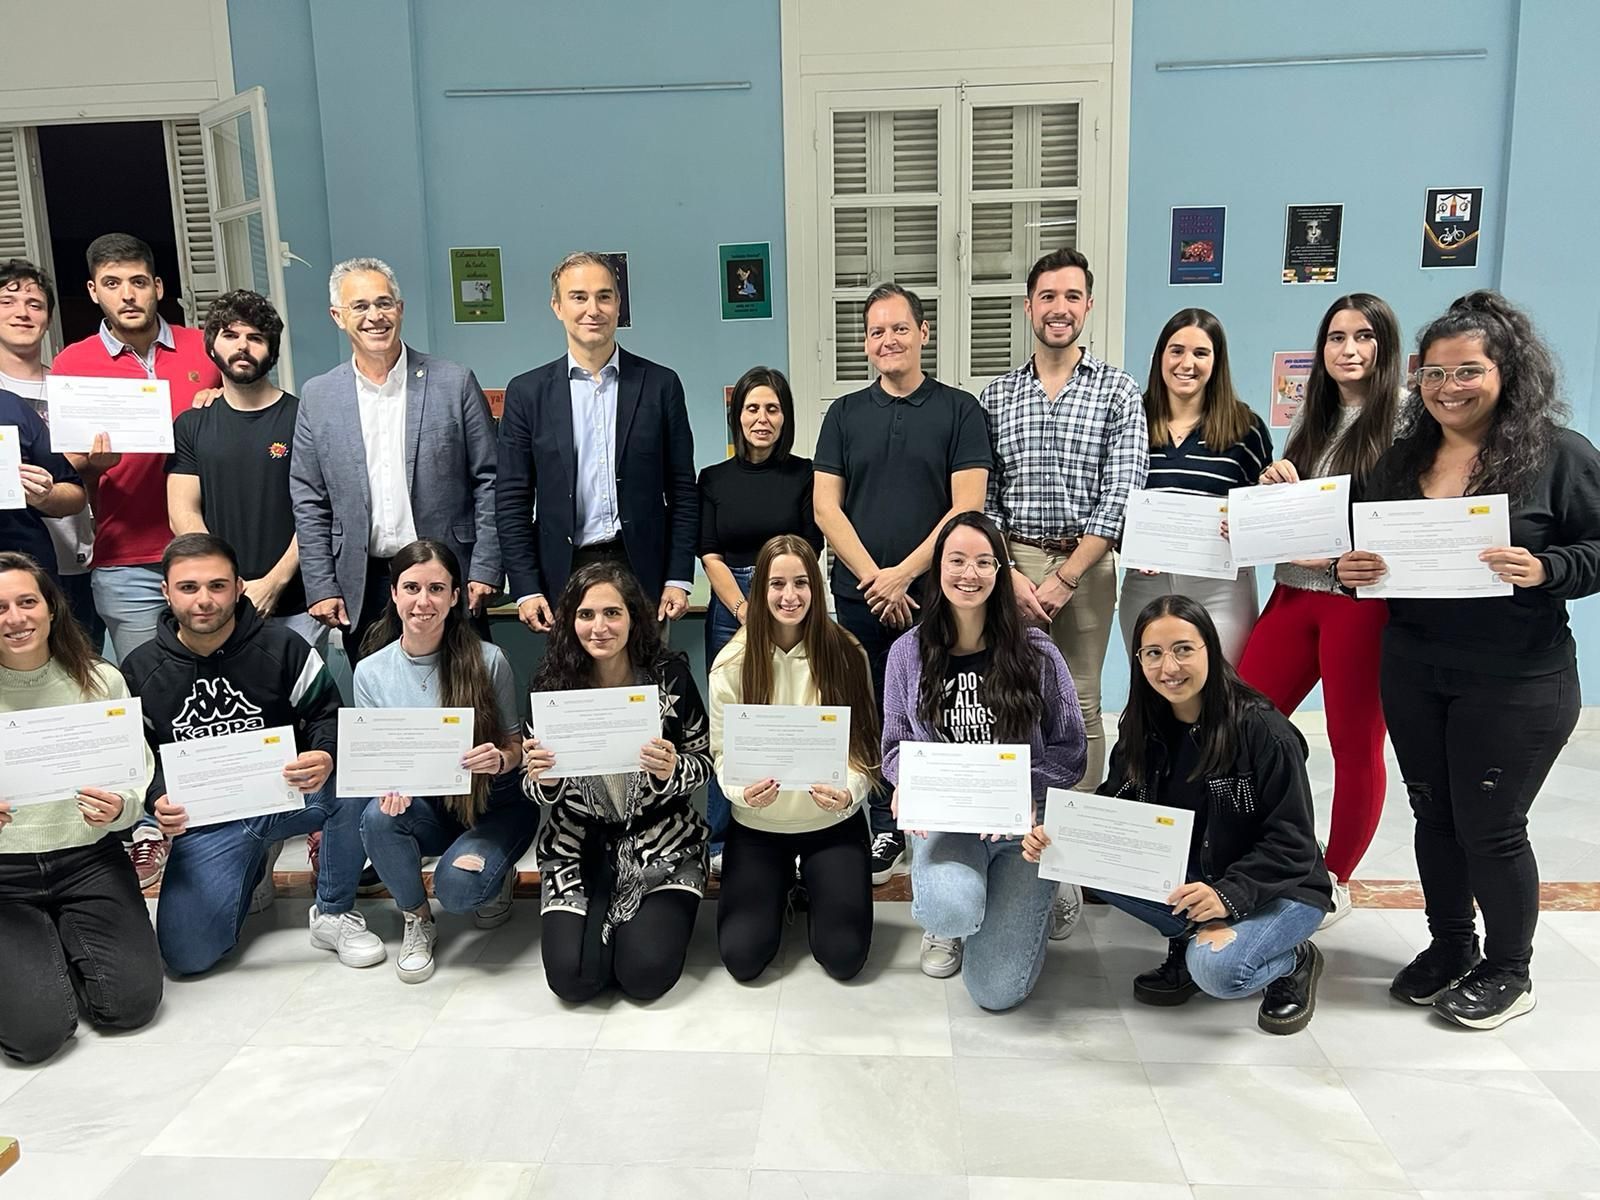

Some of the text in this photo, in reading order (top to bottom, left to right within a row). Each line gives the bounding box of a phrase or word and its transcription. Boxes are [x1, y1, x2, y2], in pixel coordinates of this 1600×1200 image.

[958, 671, 977, 691] DO
[955, 690, 982, 709] ALL
[943, 707, 998, 727] THINGS
[172, 717, 265, 743] Kappa
[950, 723, 991, 742] WITH
